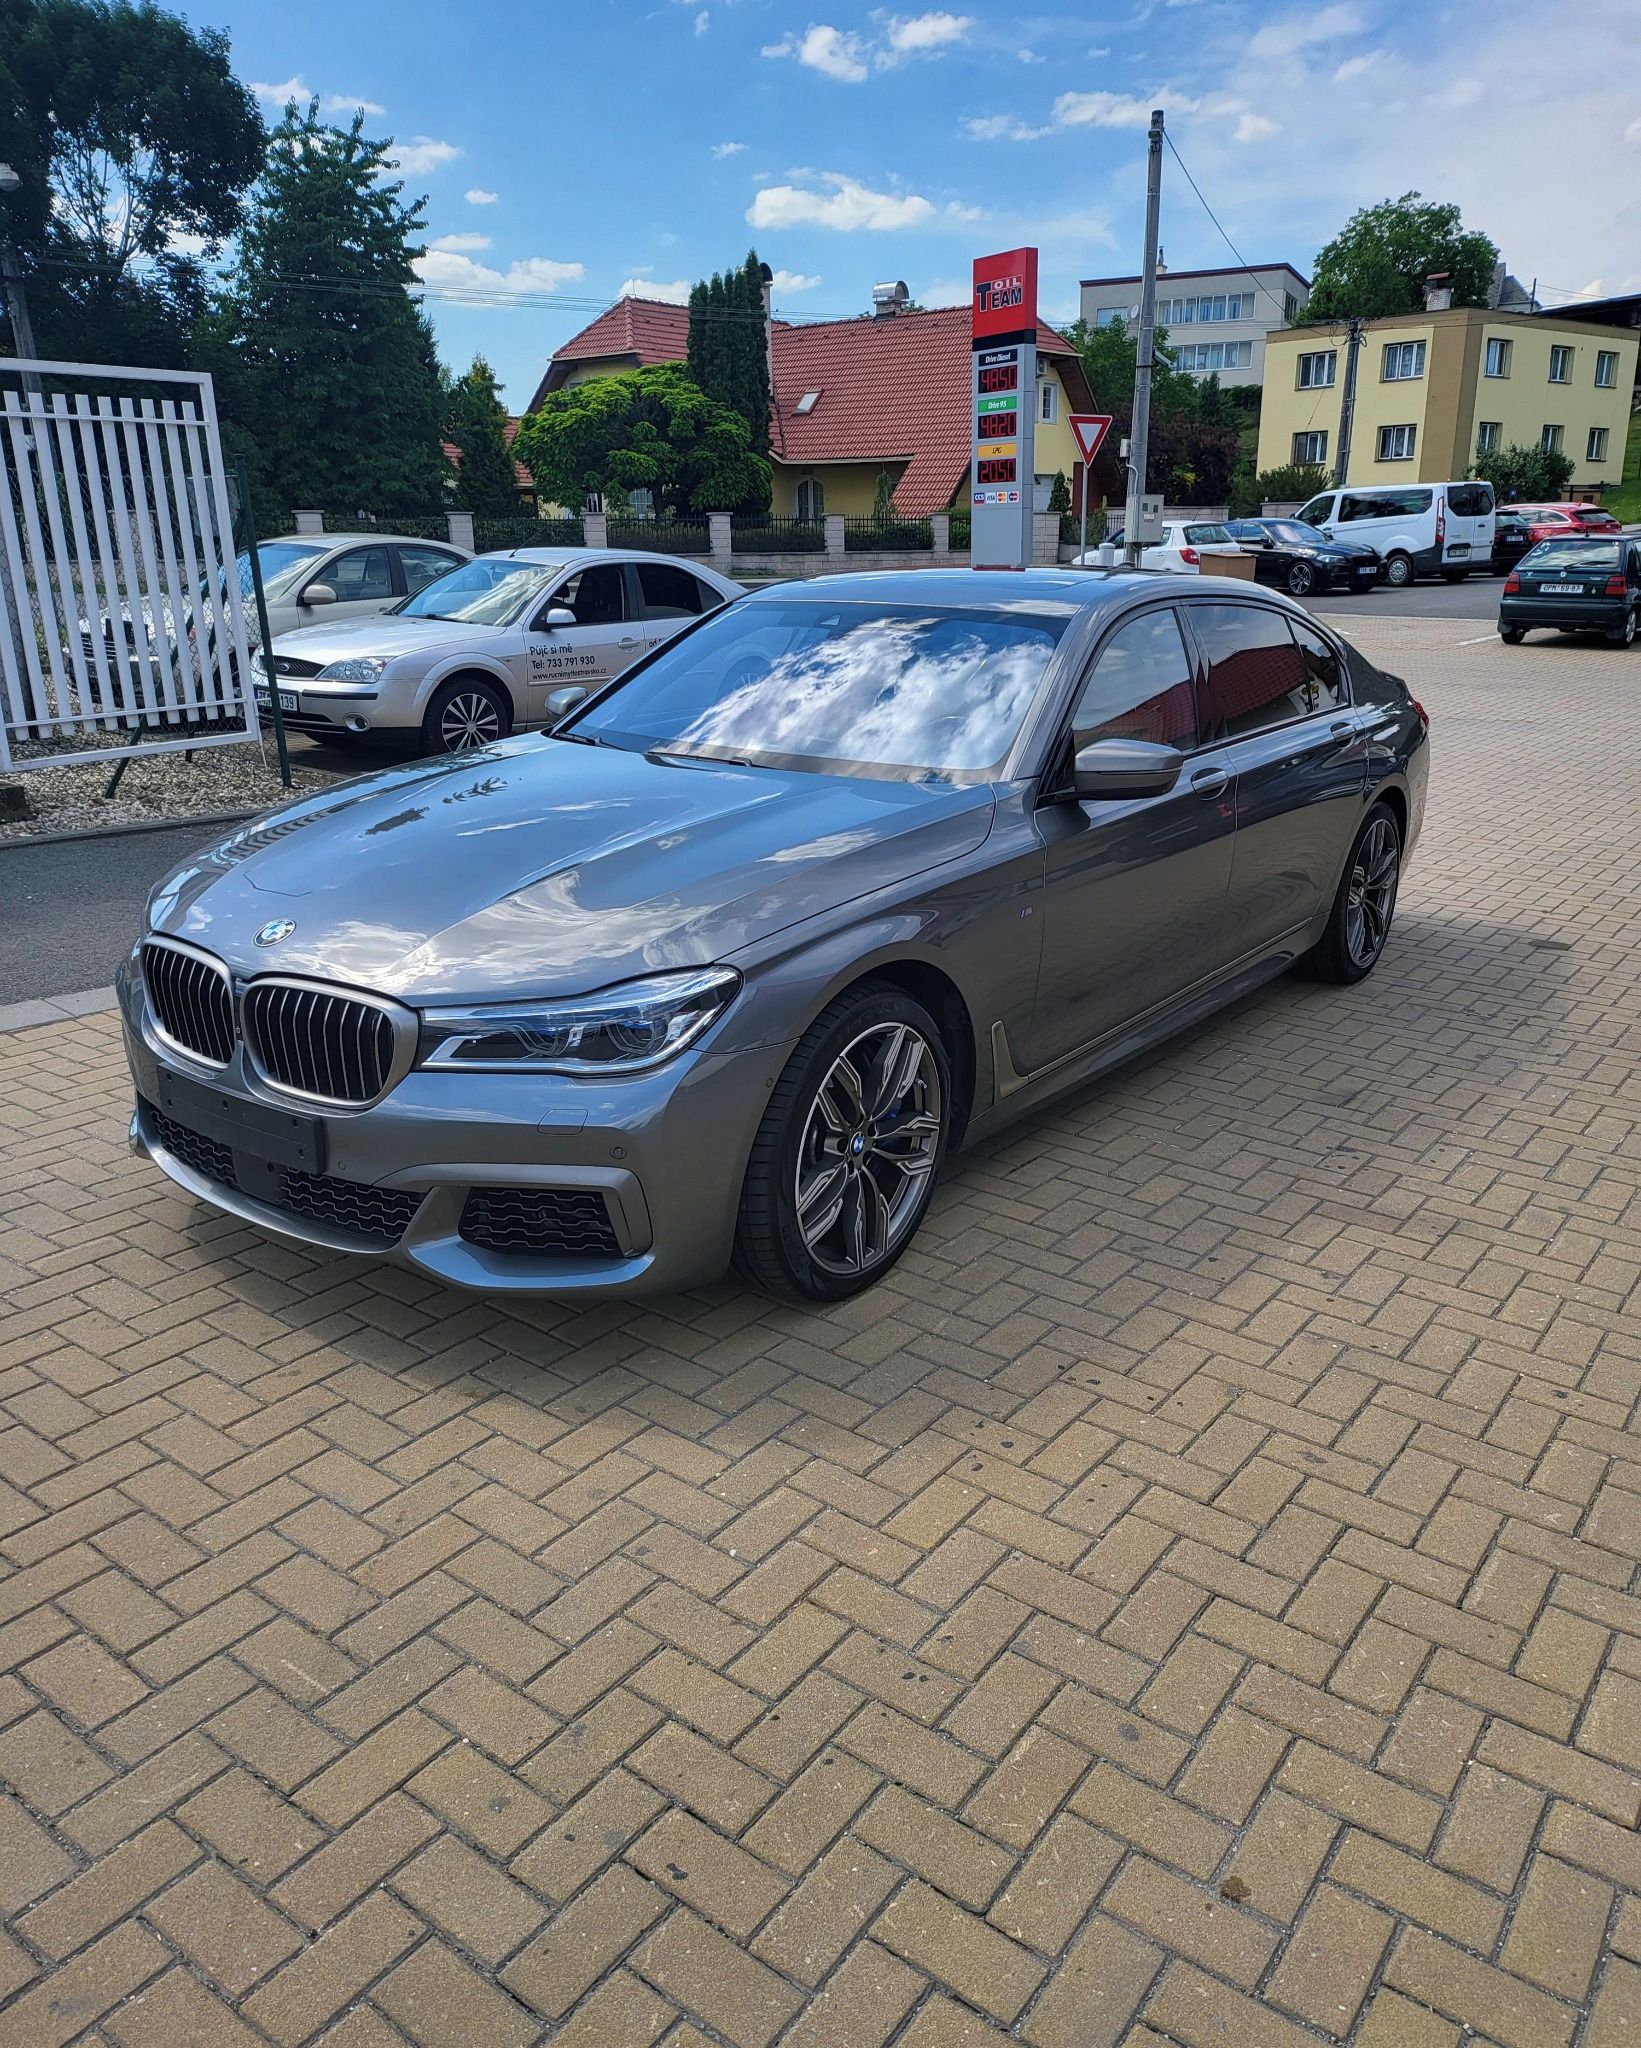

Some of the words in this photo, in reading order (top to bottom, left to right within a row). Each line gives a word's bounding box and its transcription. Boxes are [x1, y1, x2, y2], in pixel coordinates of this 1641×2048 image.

[993, 276, 1021, 290] OIL
[976, 282, 1022, 312] TEAM
[1000, 400, 1007, 408] 95
[992, 446, 1002, 454] LPG
[529, 644, 548, 657] Půjč
[550, 644, 557, 655] si
[559, 642, 573, 654] mě
[531, 660, 545, 670] Tel:
[547, 658, 563, 668] 733
[564, 656, 578, 667] 791
[580, 655, 595, 665] 930
